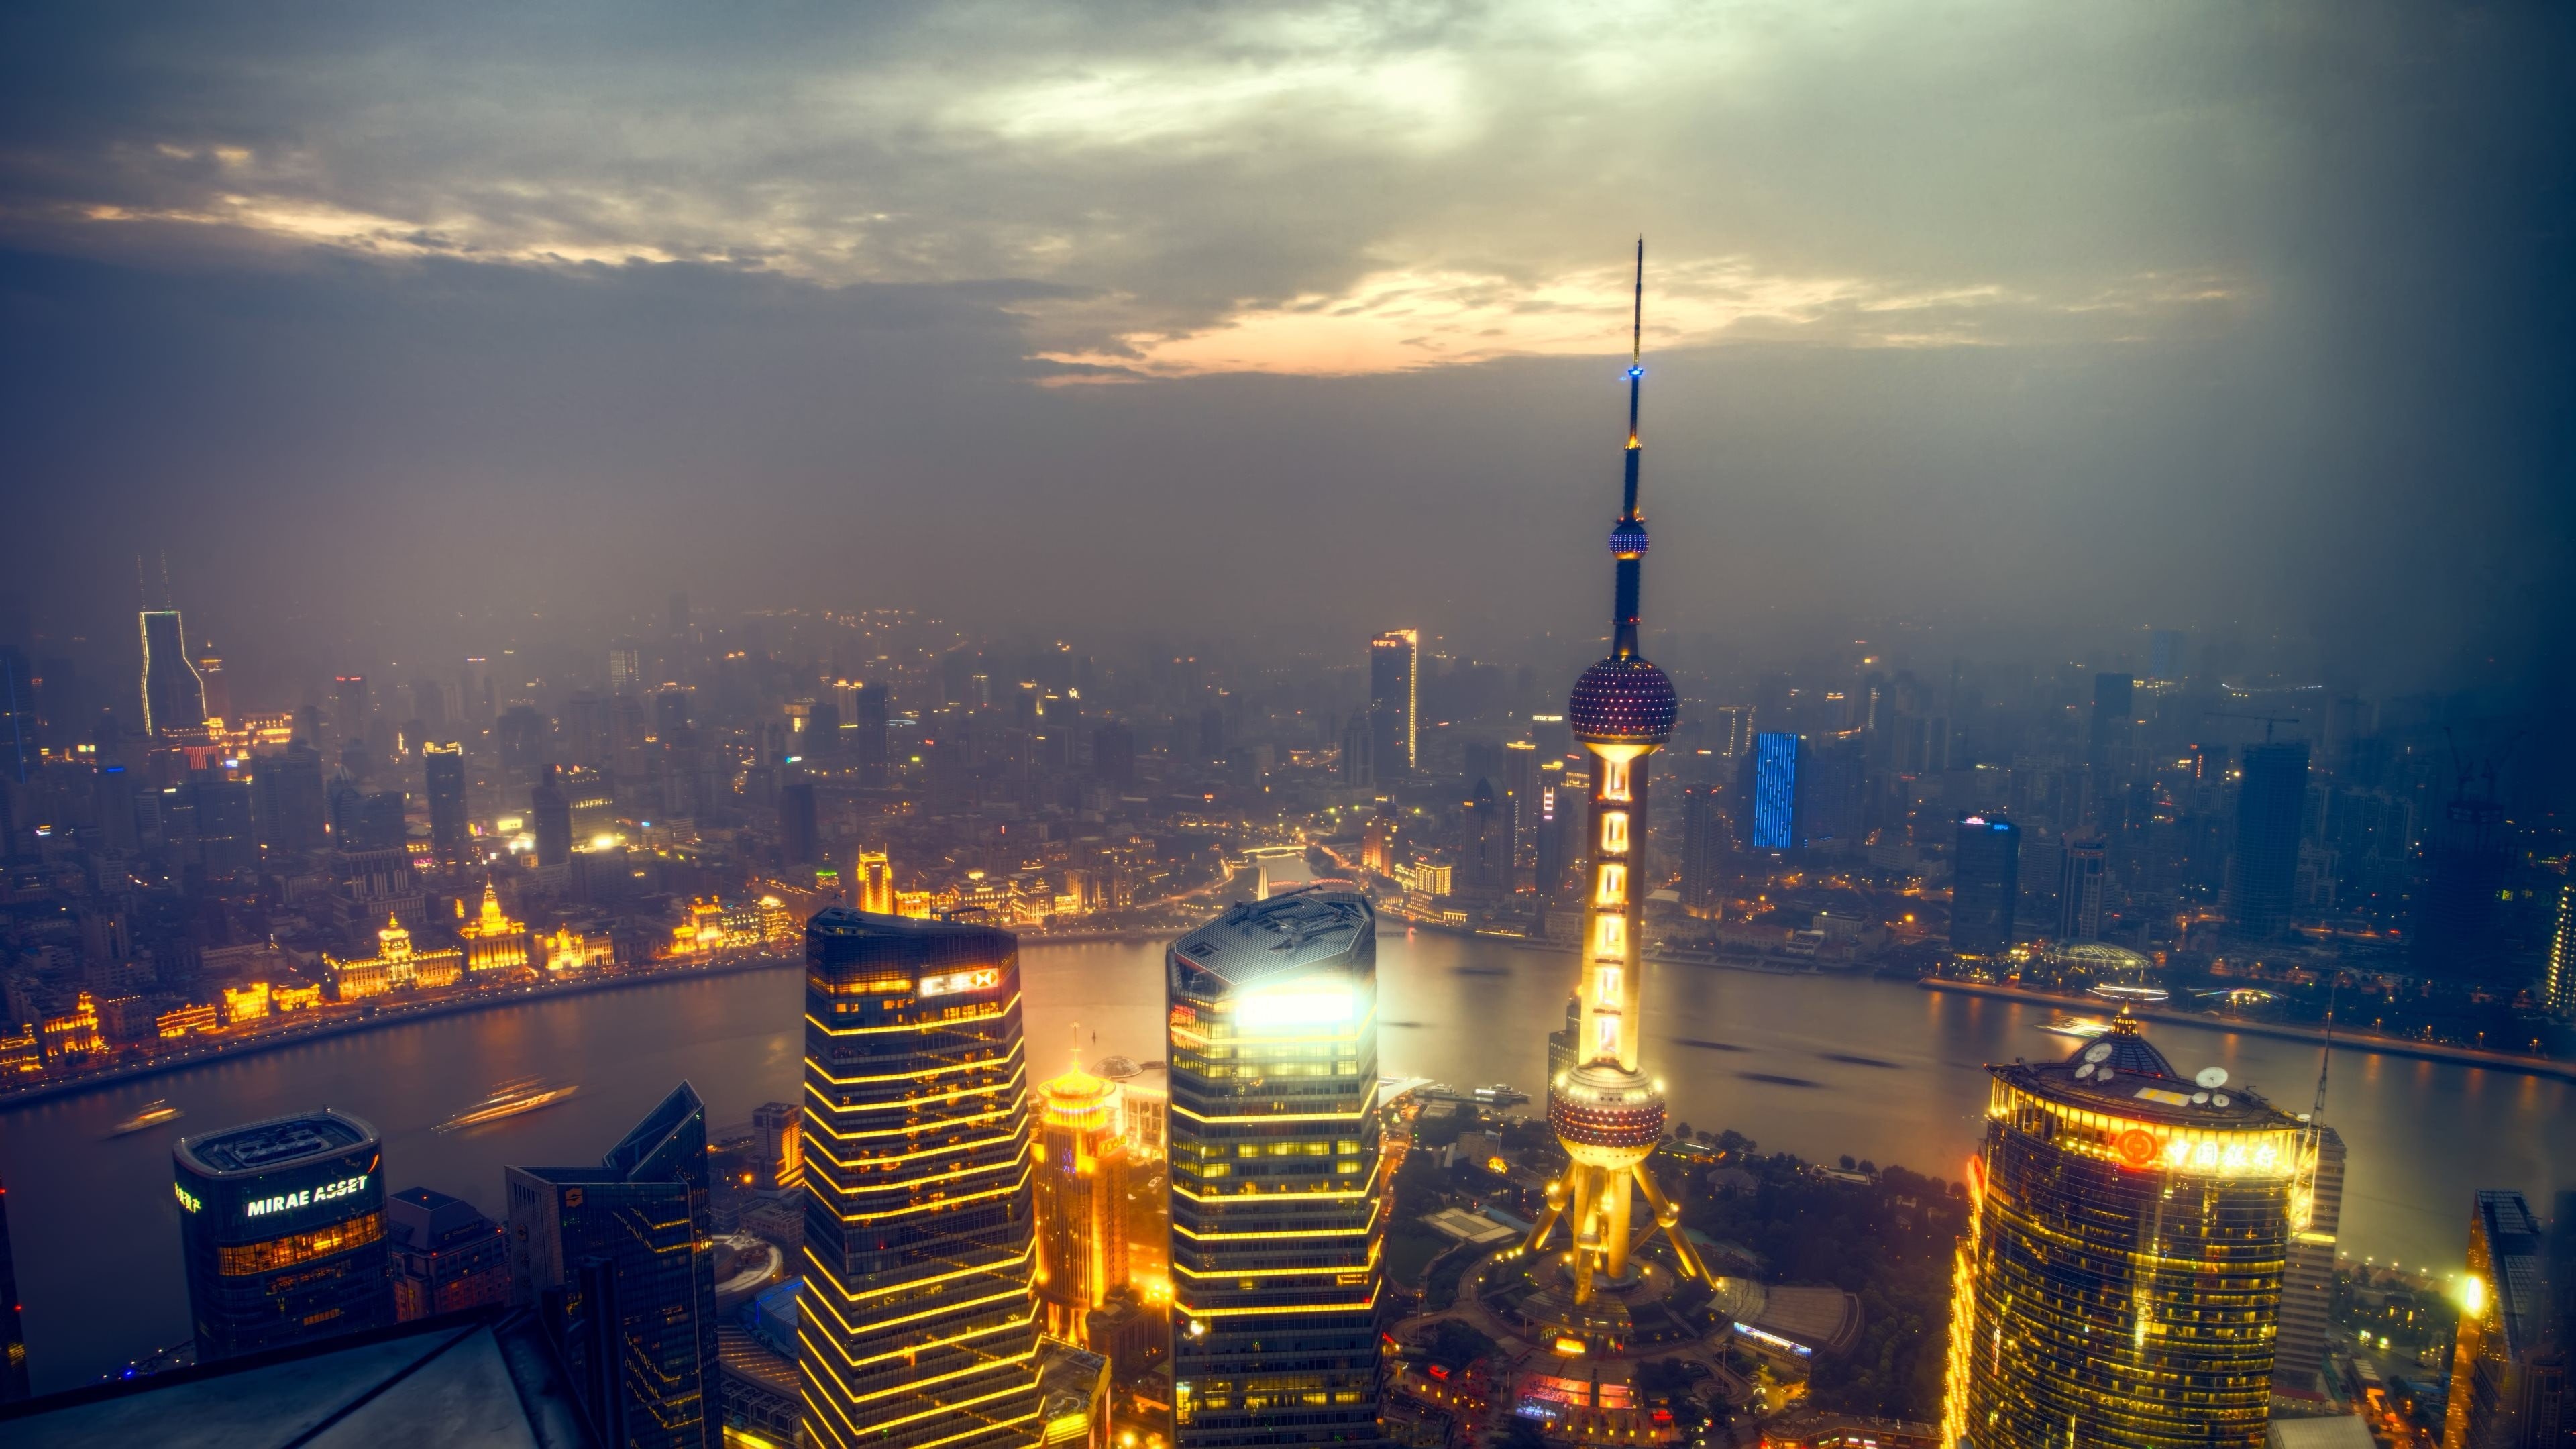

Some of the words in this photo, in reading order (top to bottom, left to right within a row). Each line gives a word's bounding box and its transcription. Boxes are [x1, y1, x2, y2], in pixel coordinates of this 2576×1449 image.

[2167, 1139, 2277, 1169] 中国银行
[248, 1190, 309, 1216] MIRAE
[313, 1175, 367, 1202] ASSET
